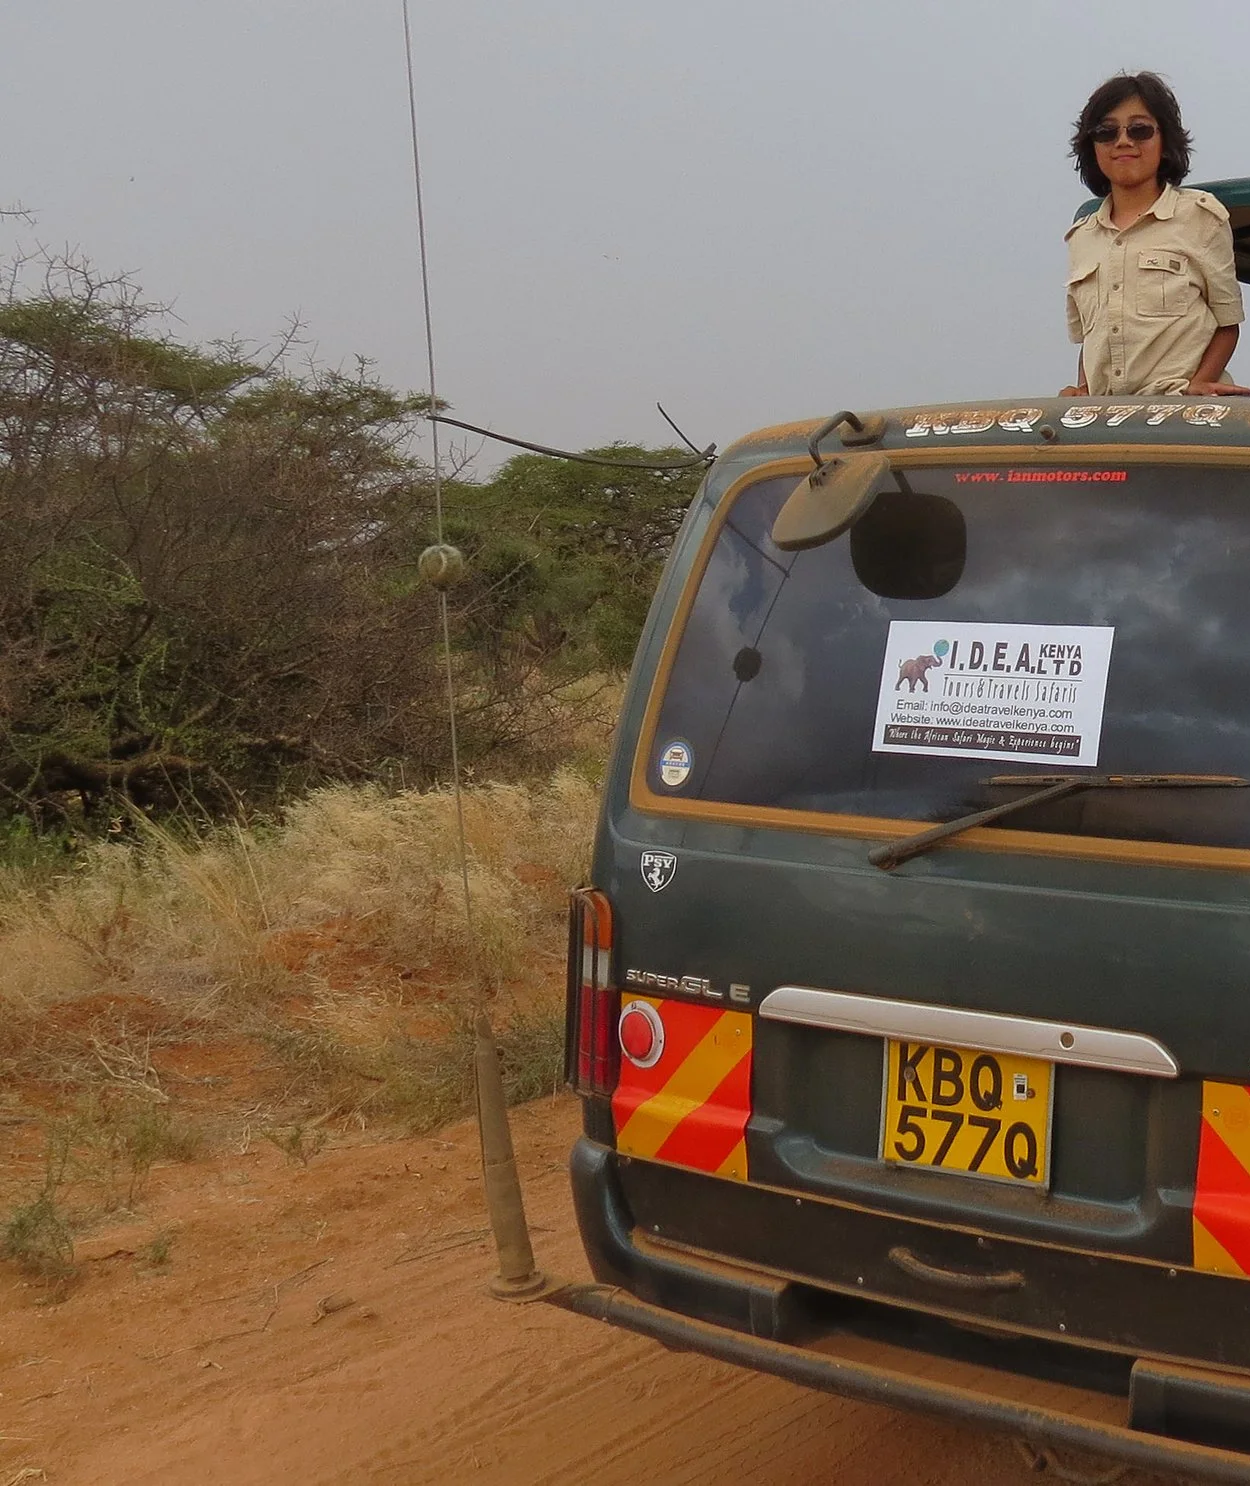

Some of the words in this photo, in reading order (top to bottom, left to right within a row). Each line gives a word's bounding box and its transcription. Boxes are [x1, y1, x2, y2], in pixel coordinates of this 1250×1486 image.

[1060, 404, 1232, 431] 577Q
[1039, 643, 1082, 660] KENYA
[1034, 680, 1078, 704] Safaris
[896, 699, 928, 712] Email:
[930, 702, 1073, 720] info@ideatravelkenya.com
[890, 712, 933, 725] Website:
[935, 716, 1075, 734] www.ideatravelkenya.com
[910, 727, 921, 740] the
[923, 729, 949, 744] African
[951, 731, 973, 745] Safari
[976, 733, 996, 750] Magic
[998, 736, 1005, 747] &
[1008, 734, 1046, 751] Experience
[730, 983, 750, 1003] E
[897, 1044, 1003, 1112] KBQ
[894, 1104, 1039, 1179] 577Q
